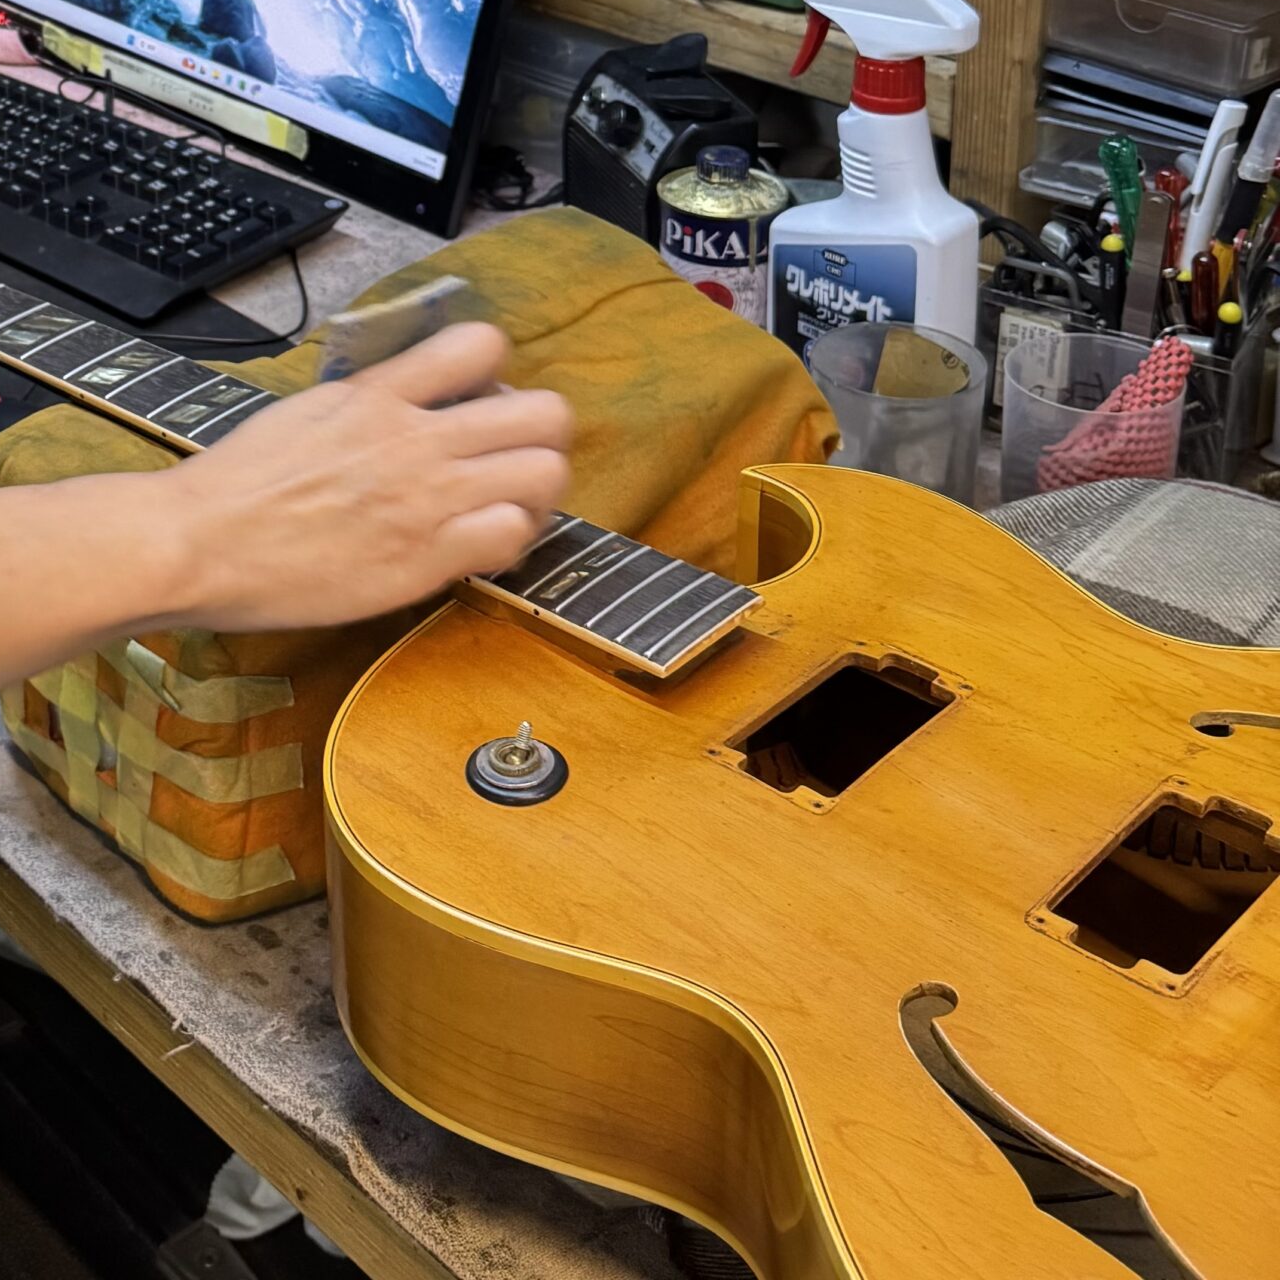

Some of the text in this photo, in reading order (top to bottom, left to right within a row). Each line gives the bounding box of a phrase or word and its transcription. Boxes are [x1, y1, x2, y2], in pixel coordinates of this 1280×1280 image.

[786, 263, 893, 322] クレポリメイト
